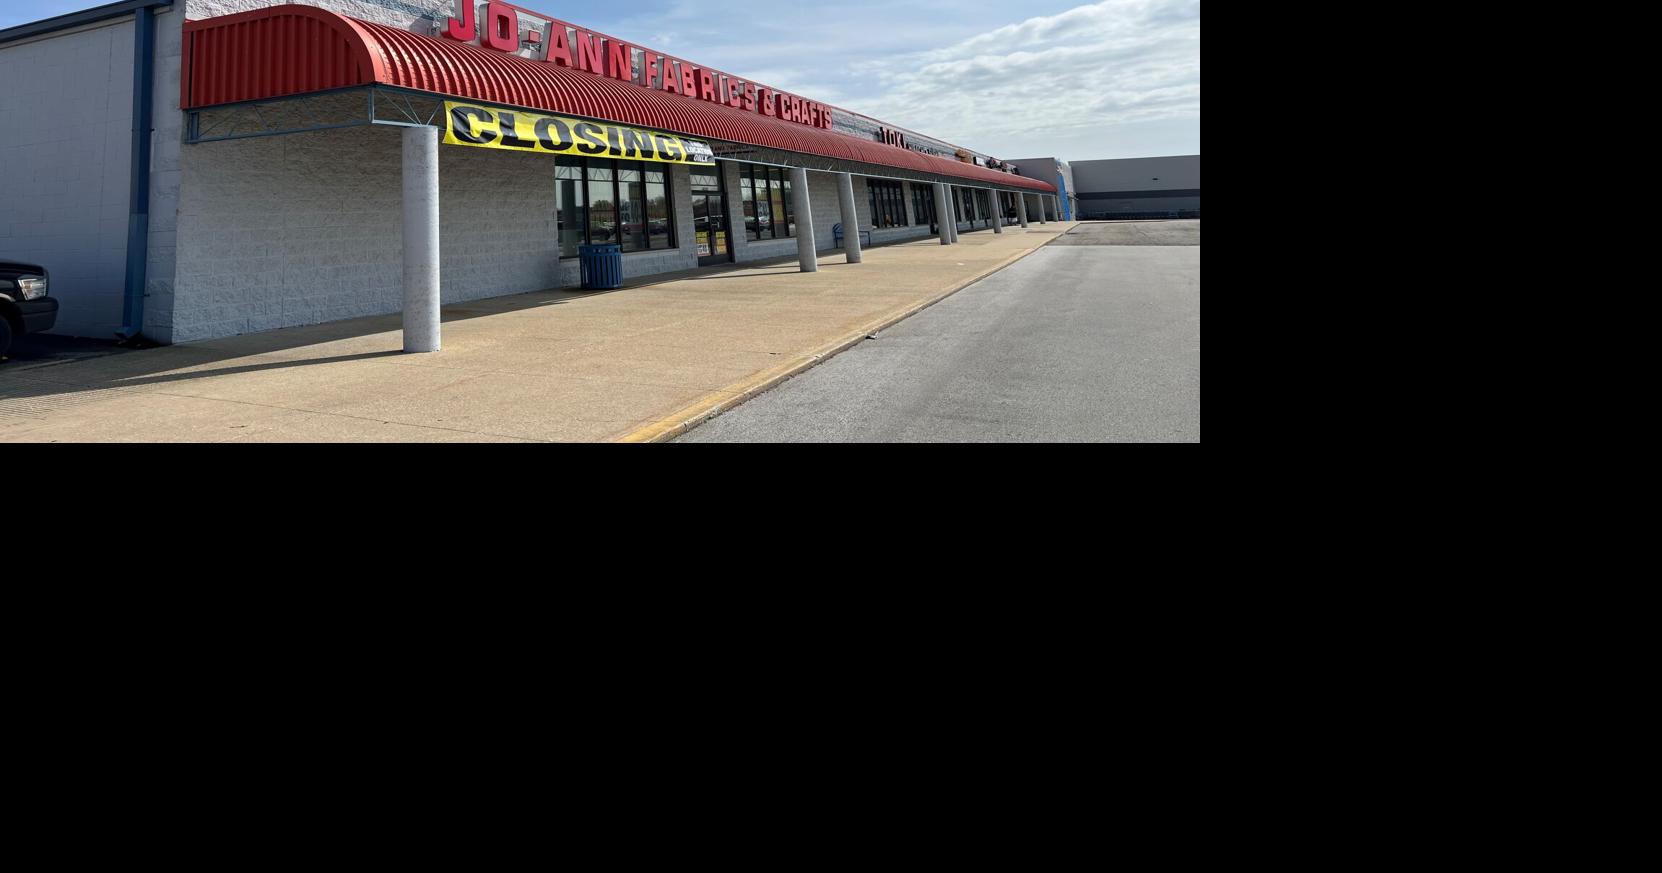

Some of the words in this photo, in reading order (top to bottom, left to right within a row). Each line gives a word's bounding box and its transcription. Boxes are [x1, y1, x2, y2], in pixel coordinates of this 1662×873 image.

[441, 0, 632, 81] JO-ANN
[644, 51, 755, 112] FABRICS
[759, 88, 775, 116] &
[777, 93, 832, 130] CRAFTS
[450, 105, 684, 161] CLOSING
